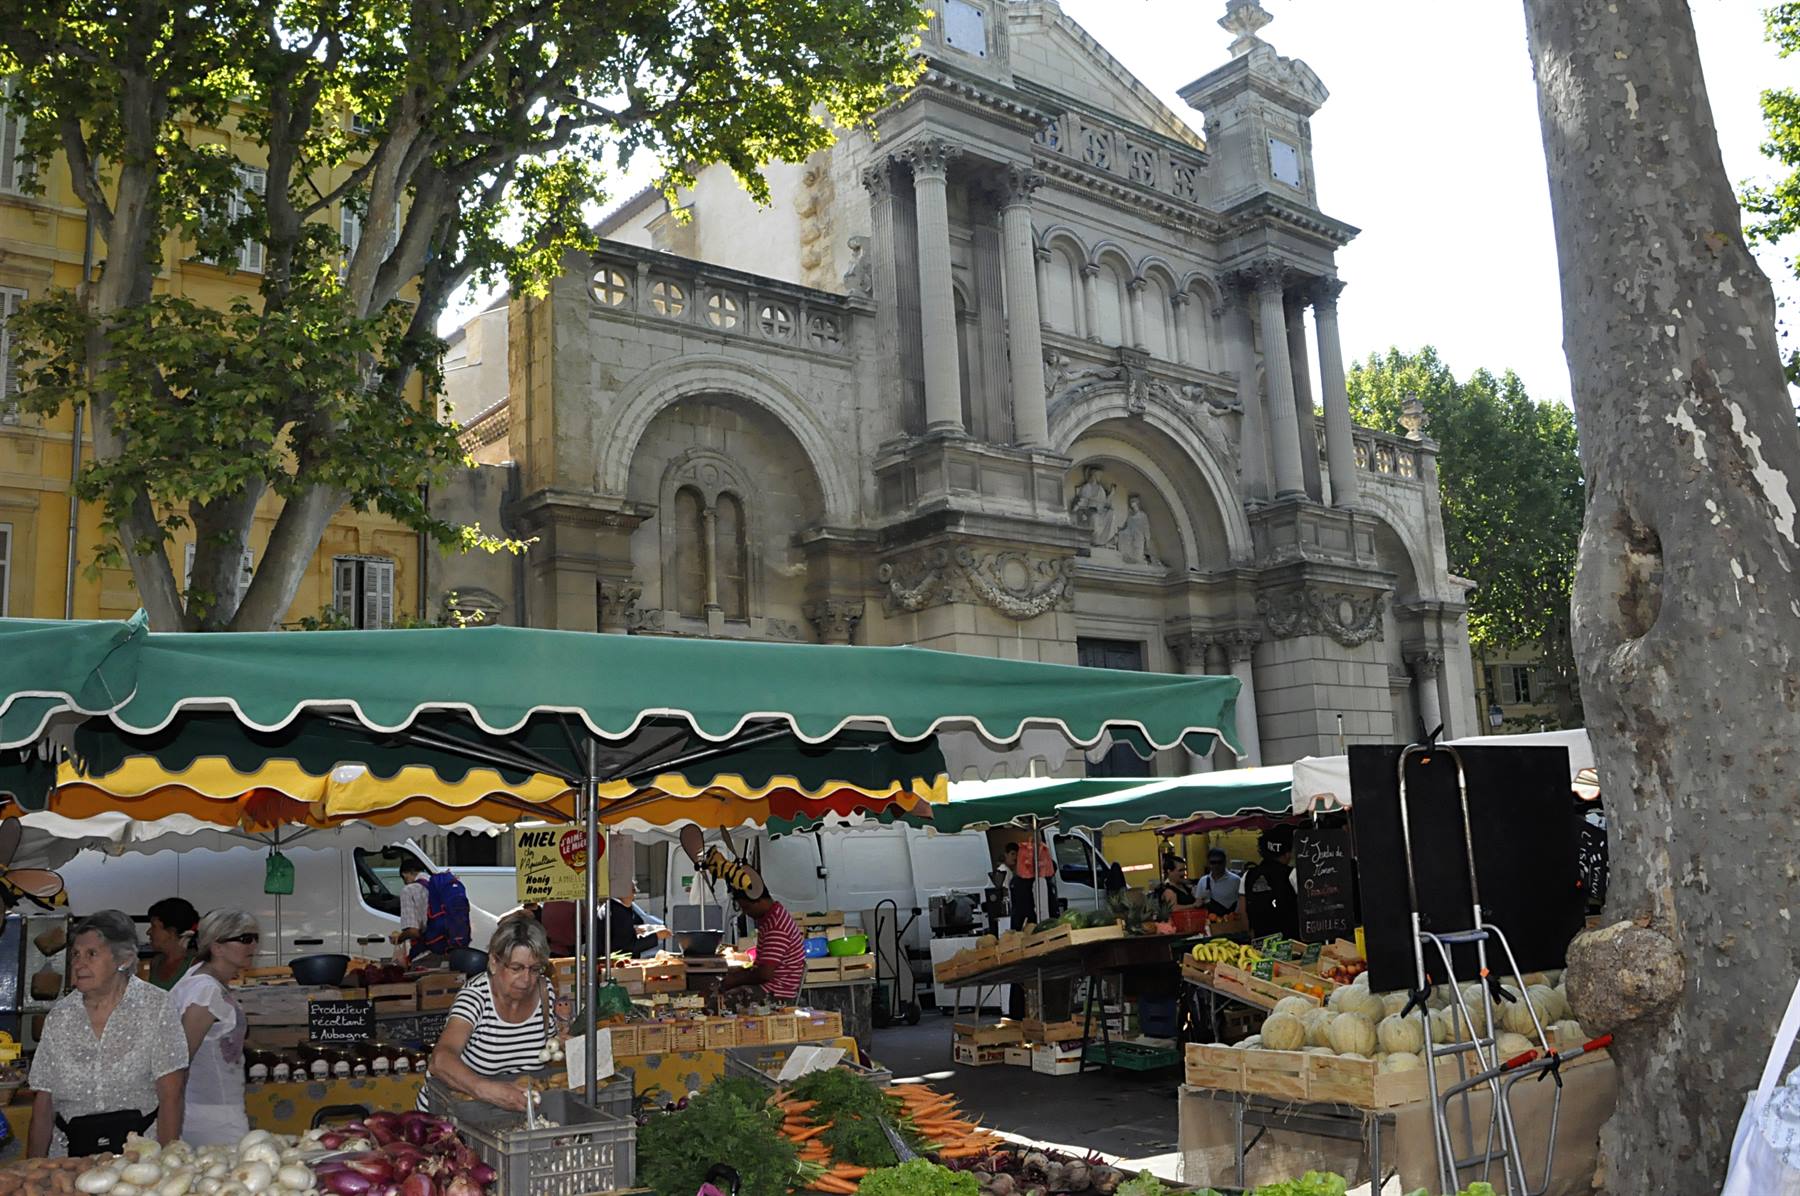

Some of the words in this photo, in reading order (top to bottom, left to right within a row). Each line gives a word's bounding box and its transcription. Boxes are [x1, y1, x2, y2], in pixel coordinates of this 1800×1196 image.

[518, 831, 556, 848] MIEL
[562, 845, 571, 855] LE
[526, 875, 550, 886] Honig
[526, 885, 553, 896] Honey
[310, 1003, 369, 1015] Producteur
[312, 1016, 367, 1026] récoltant
[320, 1028, 369, 1041] Aubagne
